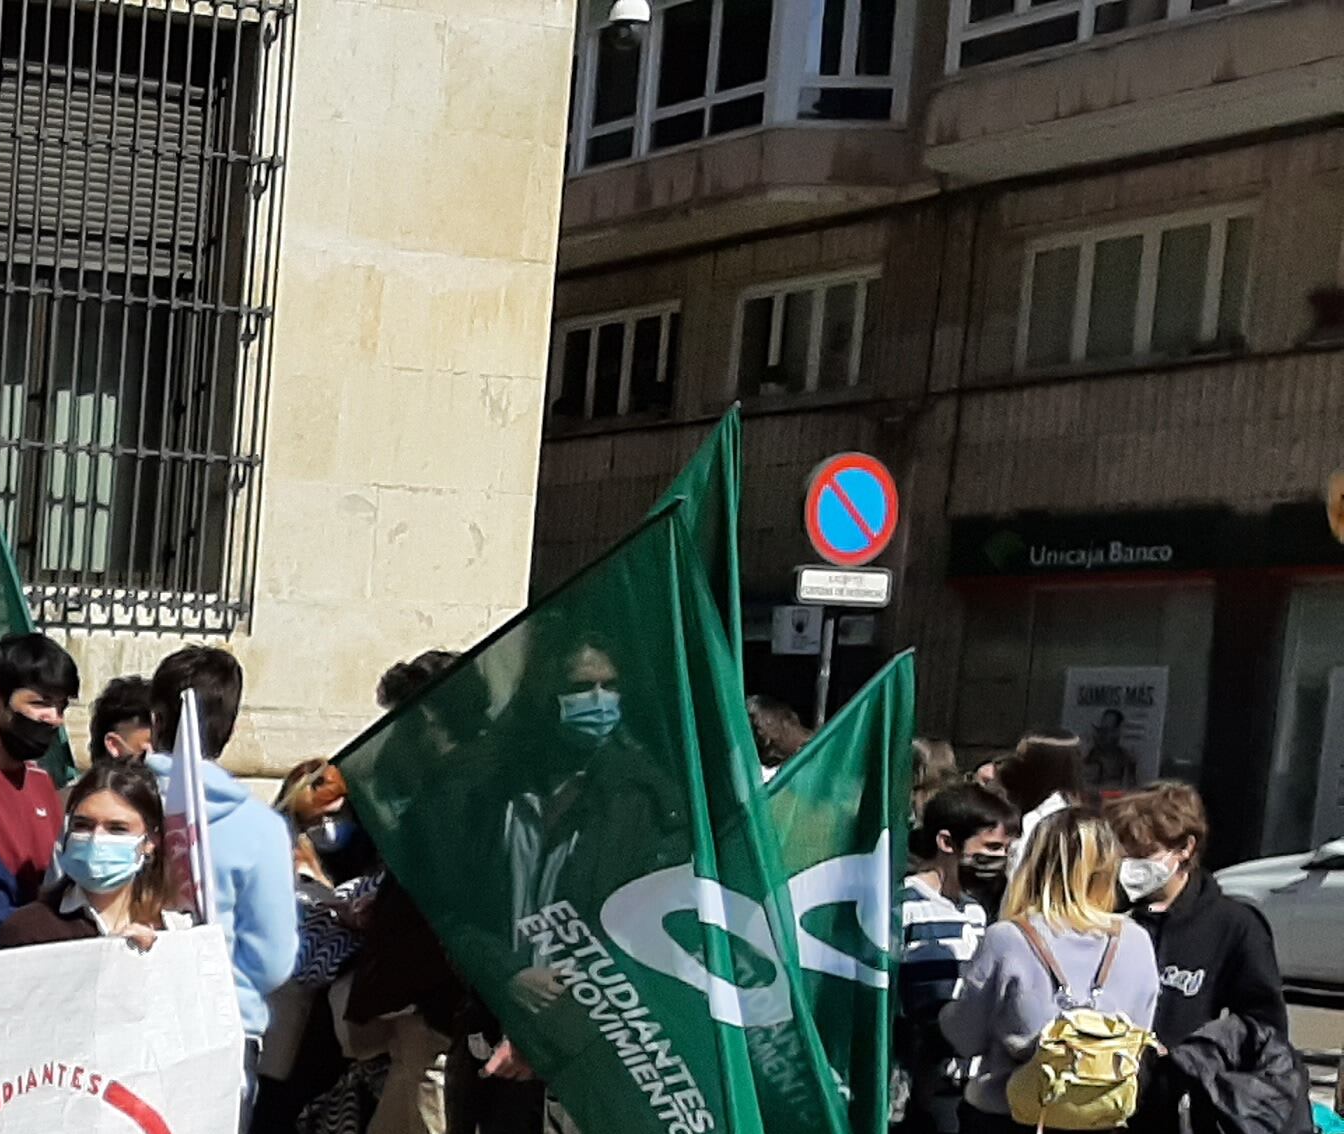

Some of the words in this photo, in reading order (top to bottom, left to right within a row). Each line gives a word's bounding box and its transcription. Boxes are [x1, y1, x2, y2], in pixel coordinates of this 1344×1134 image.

[1029, 545, 1104, 569] Unicaja
[1109, 540, 1174, 564] Banco
[516, 913, 566, 958] EN
[539, 900, 715, 1134] ESTUDIANTES
